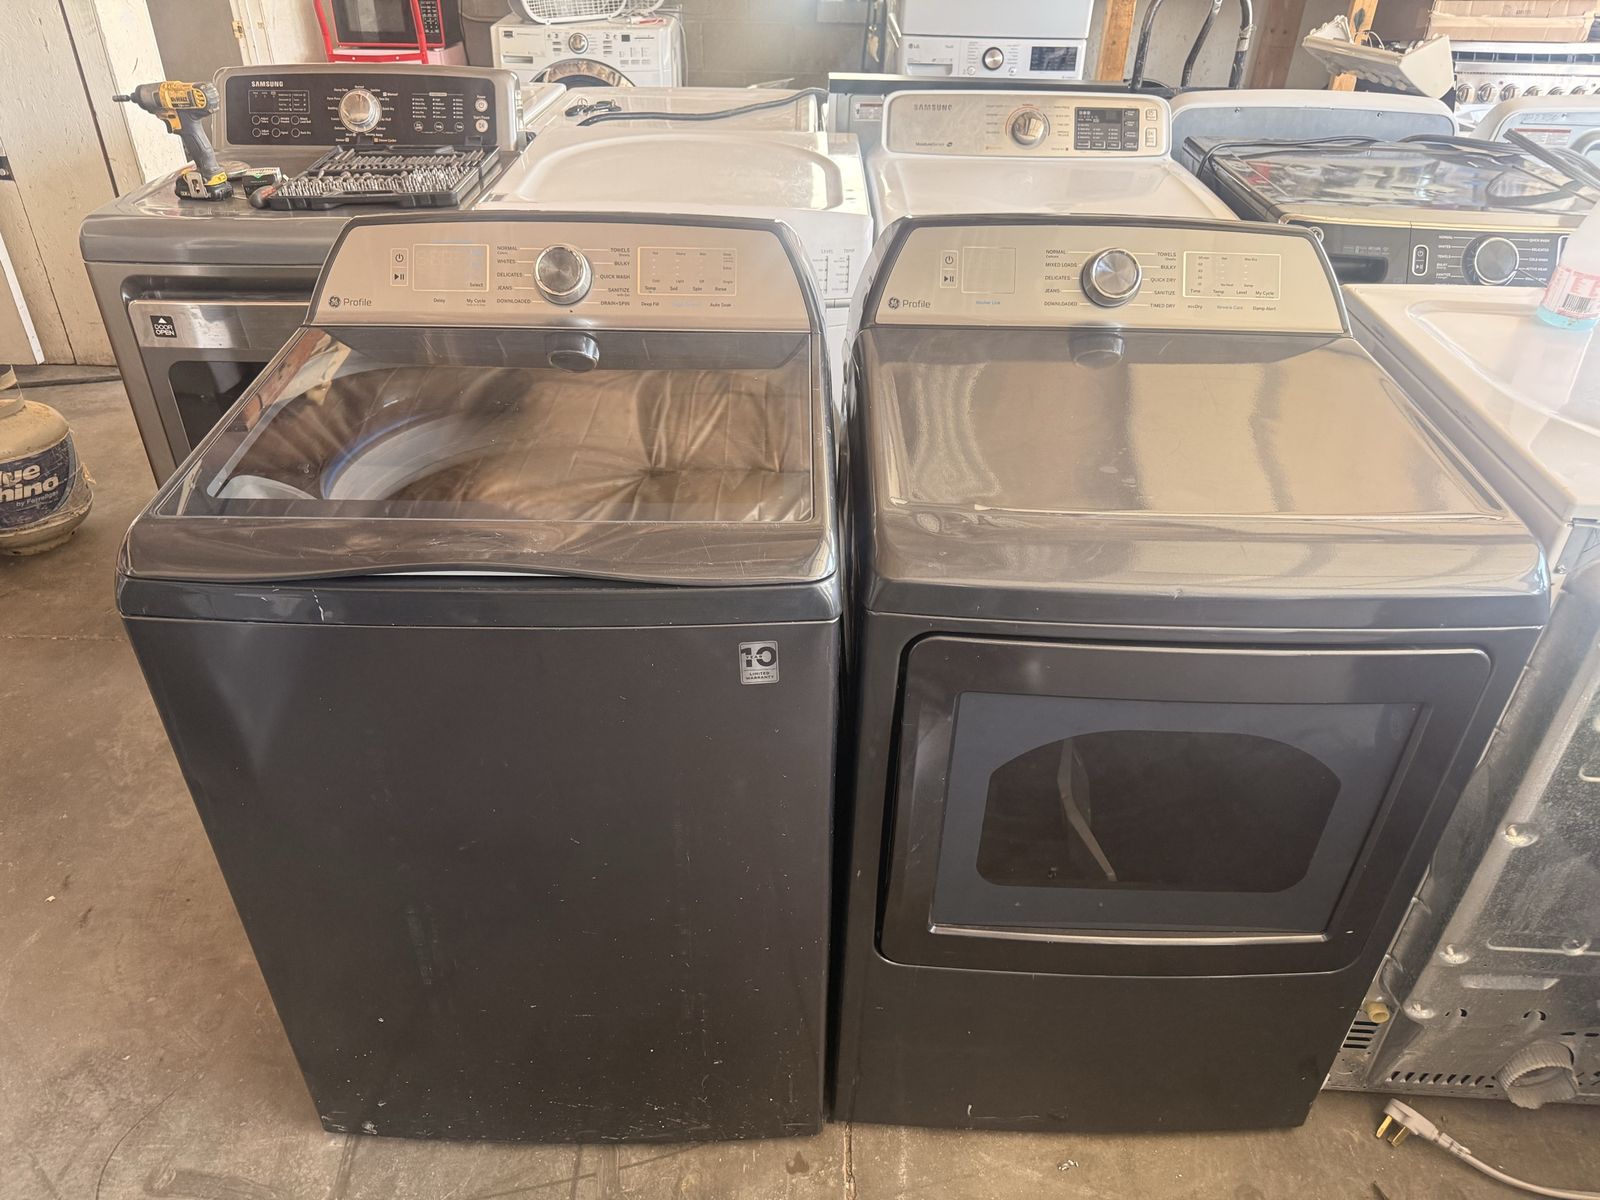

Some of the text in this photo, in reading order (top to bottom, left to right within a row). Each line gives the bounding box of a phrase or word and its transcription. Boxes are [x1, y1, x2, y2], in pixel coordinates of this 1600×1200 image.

[343, 298, 372, 306] Profile
[902, 300, 931, 308] Profile
[740, 646, 777, 668] 10
